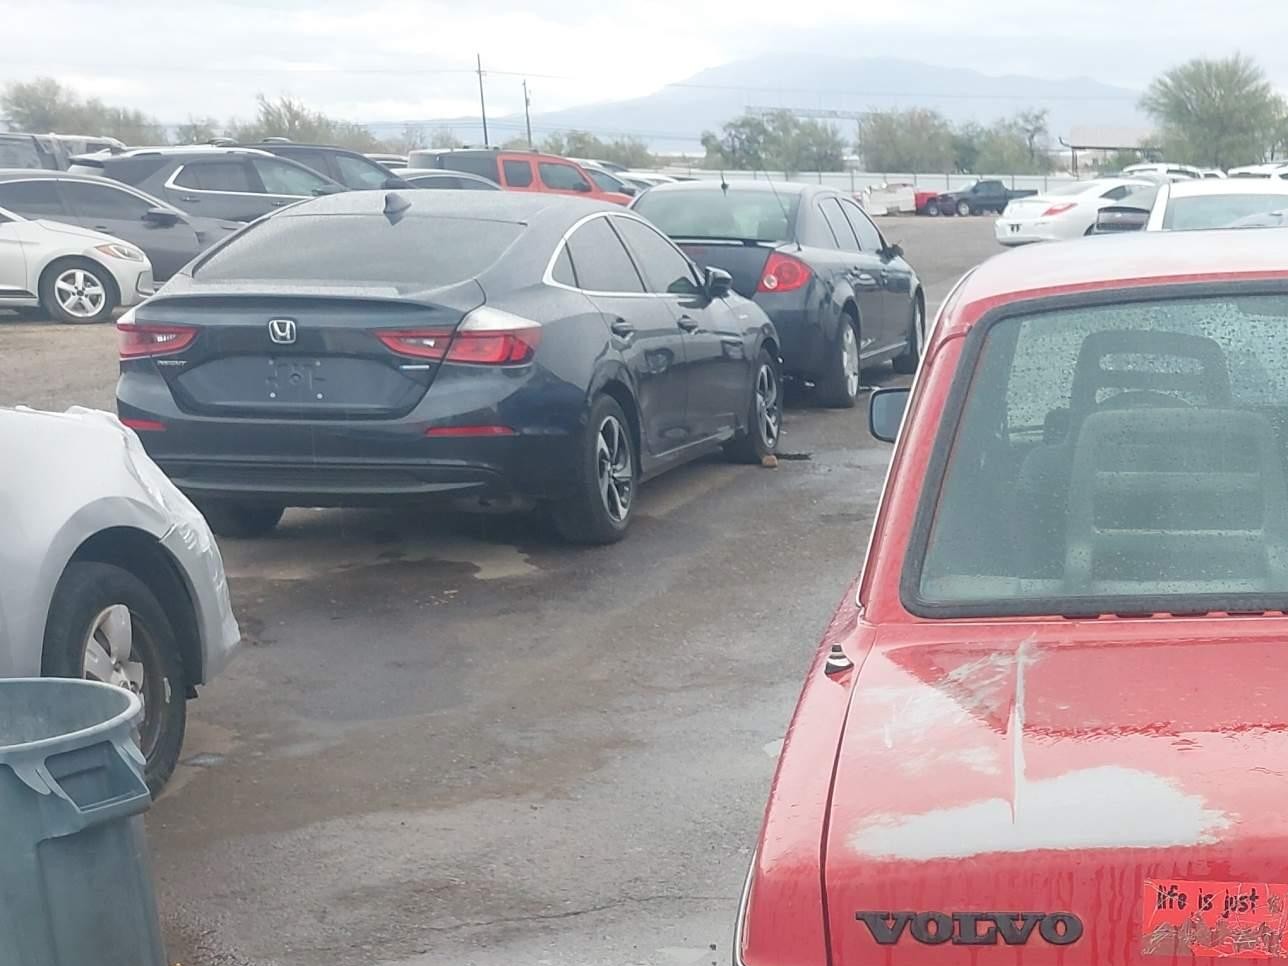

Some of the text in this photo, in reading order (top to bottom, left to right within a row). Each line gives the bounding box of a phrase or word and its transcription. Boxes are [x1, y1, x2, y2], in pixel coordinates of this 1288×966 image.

[1157, 885, 1188, 911] life
[1198, 888, 1214, 911] is
[1224, 888, 1260, 919] just
[856, 911, 1084, 945] VOLVO
